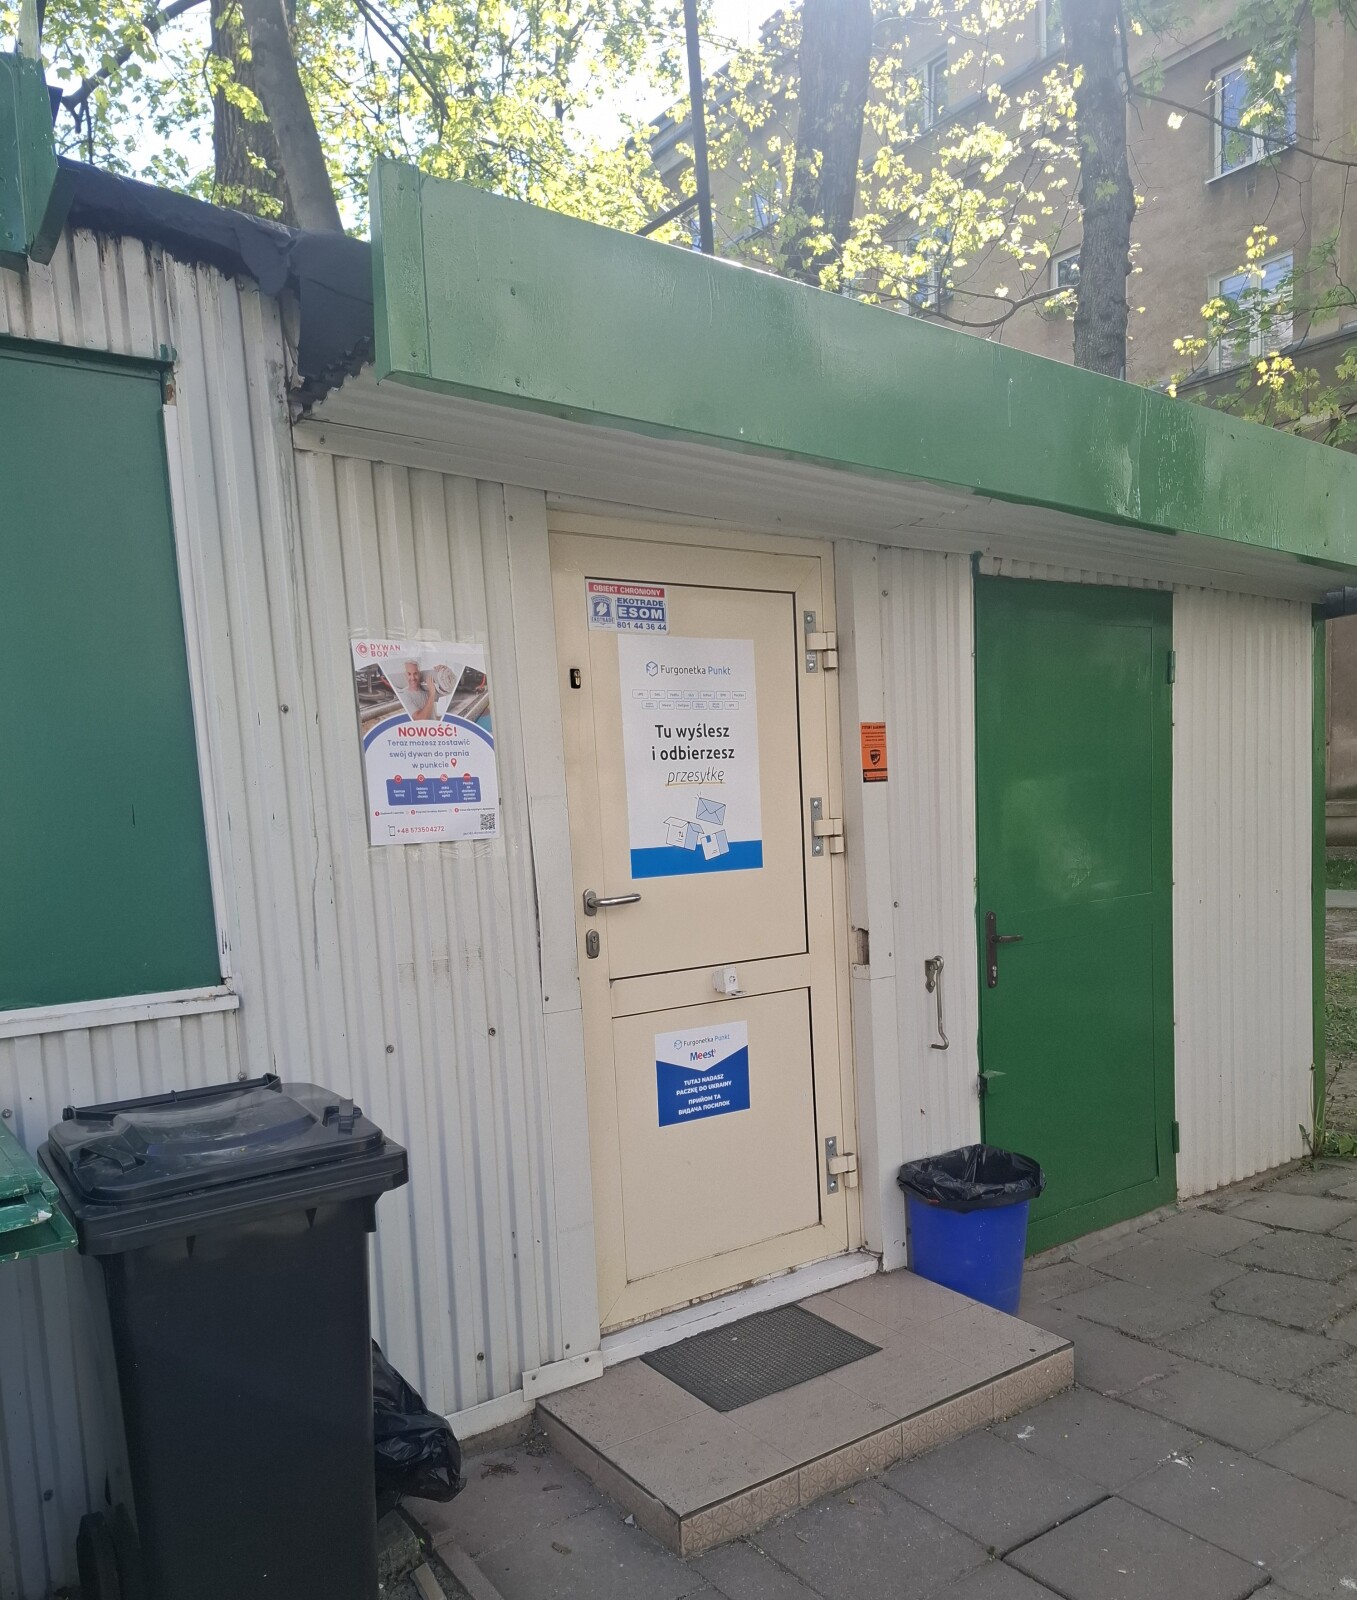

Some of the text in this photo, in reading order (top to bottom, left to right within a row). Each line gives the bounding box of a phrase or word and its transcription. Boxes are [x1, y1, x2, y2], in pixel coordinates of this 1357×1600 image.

[593, 585, 661, 596] OBIEKT CHRONIONY
[617, 597, 663, 607] EKOTRADE
[618, 607, 663, 619] ESOM
[617, 621, 631, 629] 801
[634, 622, 643, 630] 44
[370, 643, 400, 651] DYWAN
[371, 650, 388, 658] BOX
[660, 665, 731, 676] Furgonetka Punkt
[398, 724, 457, 737] NOWOŚĆ!
[655, 723, 729, 741] Tu wyślesz
[409, 739, 436, 747] możesz
[389, 751, 406, 759] swój
[408, 751, 433, 759] dywan
[445, 750, 470, 758] prania
[652, 745, 735, 760] i odbierzesz
[420, 761, 449, 770] punkcie
[667, 766, 725, 785] przesyłkę
[683, 1037, 713, 1047] Furgonetka
[690, 1049, 715, 1061] Meest
[684, 1074, 724, 1086] TUTAJ NADASZ
[676, 1087, 698, 1096] PACZKĘ
[708, 1080, 732, 1090] UKRAINY
[678, 1100, 731, 1115] ВИДАЧА ПОСИЛОК
